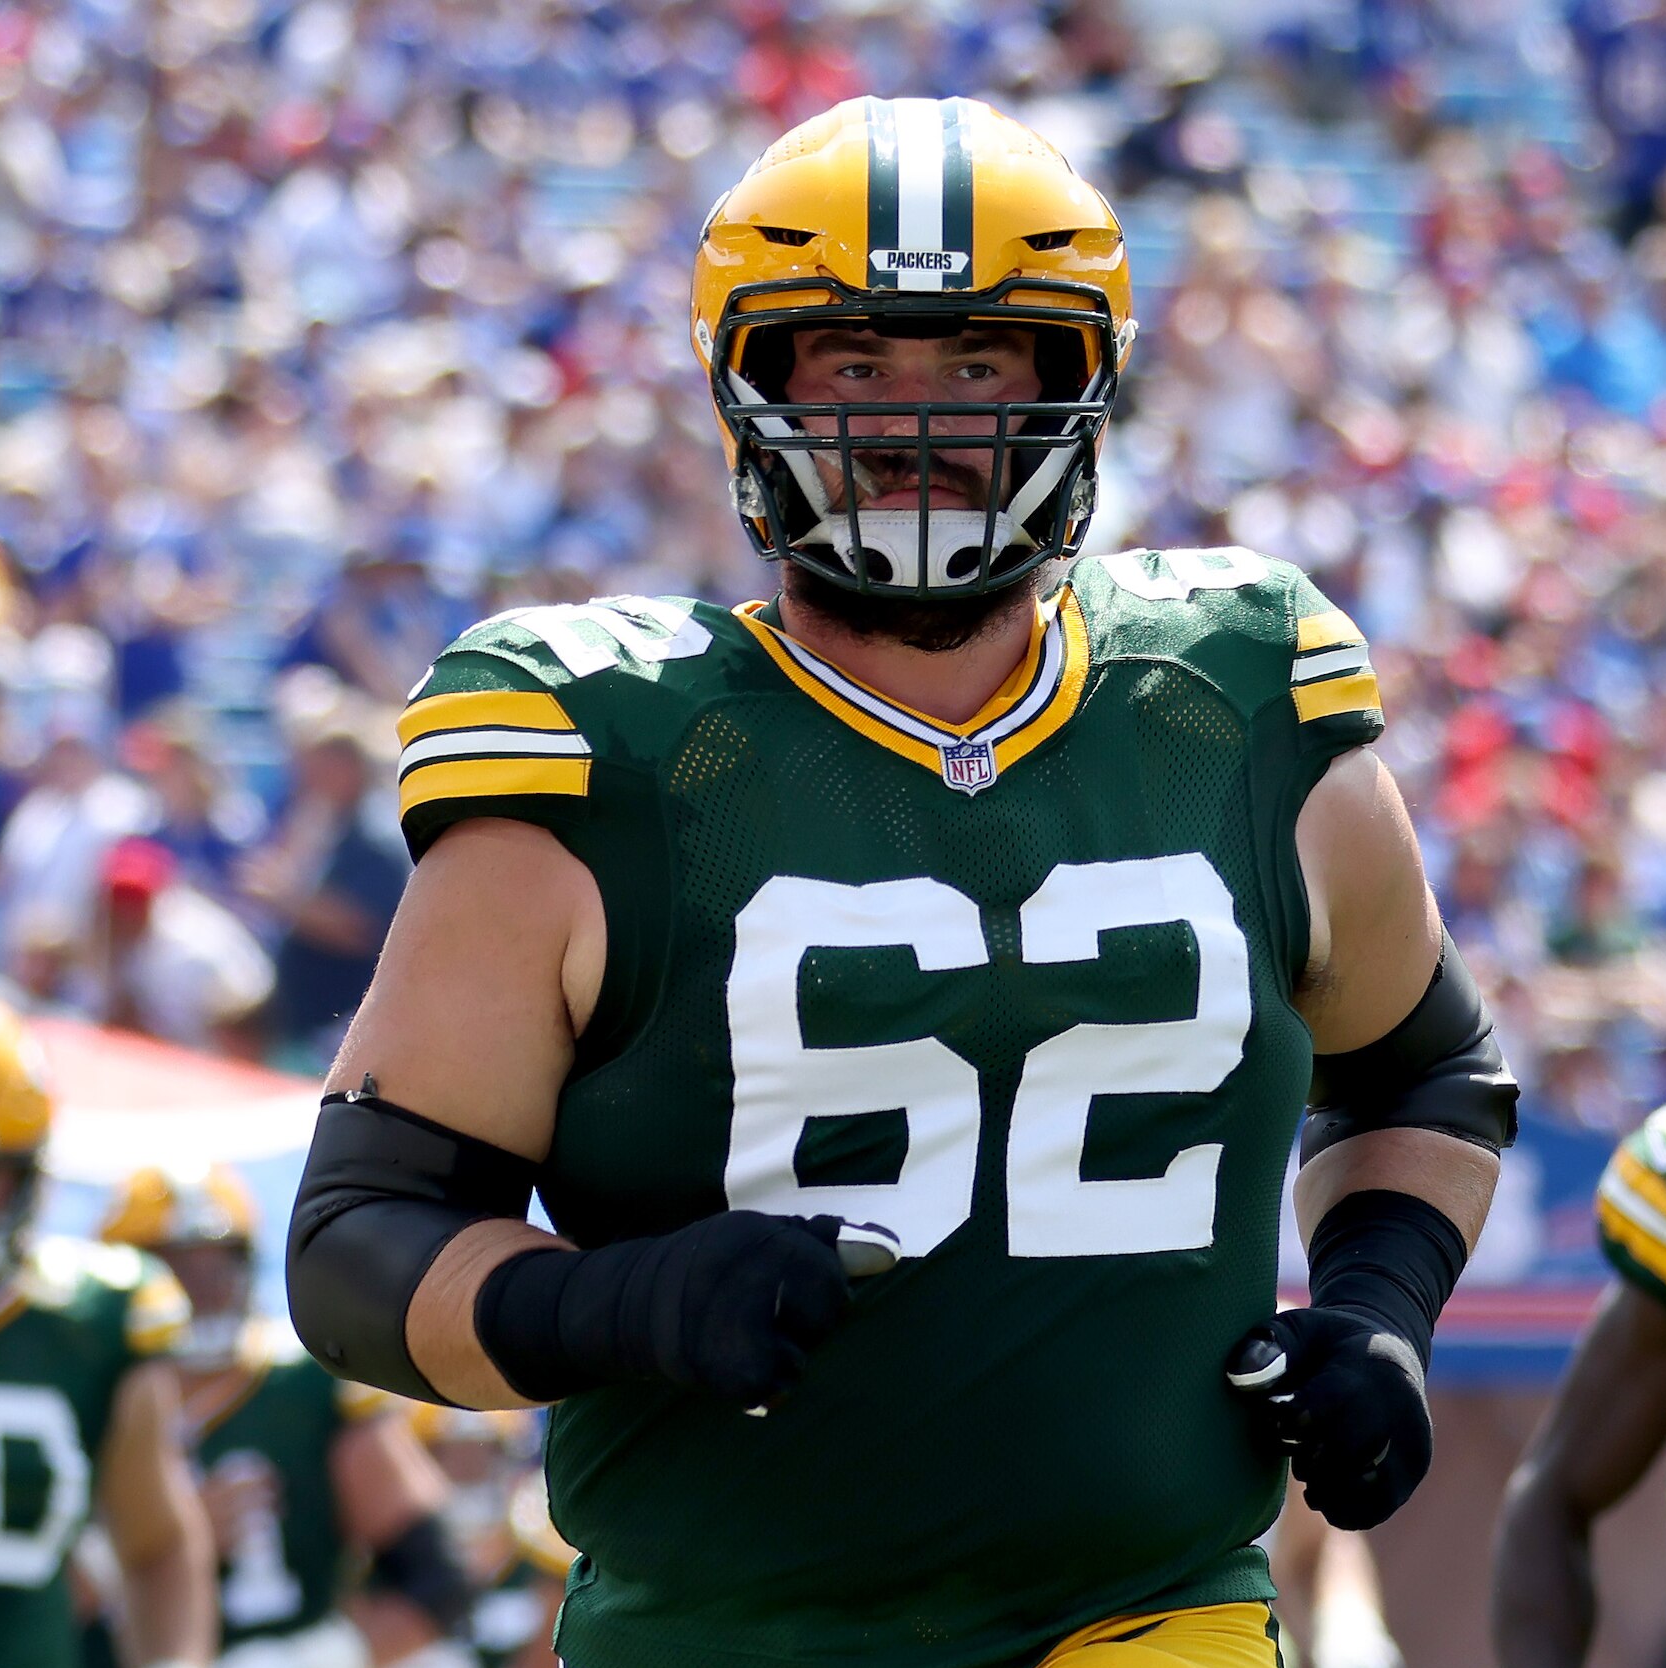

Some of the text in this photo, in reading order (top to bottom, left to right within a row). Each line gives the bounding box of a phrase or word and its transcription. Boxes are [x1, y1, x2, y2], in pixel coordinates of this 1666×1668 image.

[886, 251, 953, 270] PACKERS
[950, 758, 988, 783] NFL
[724, 852, 1252, 1258] 62
